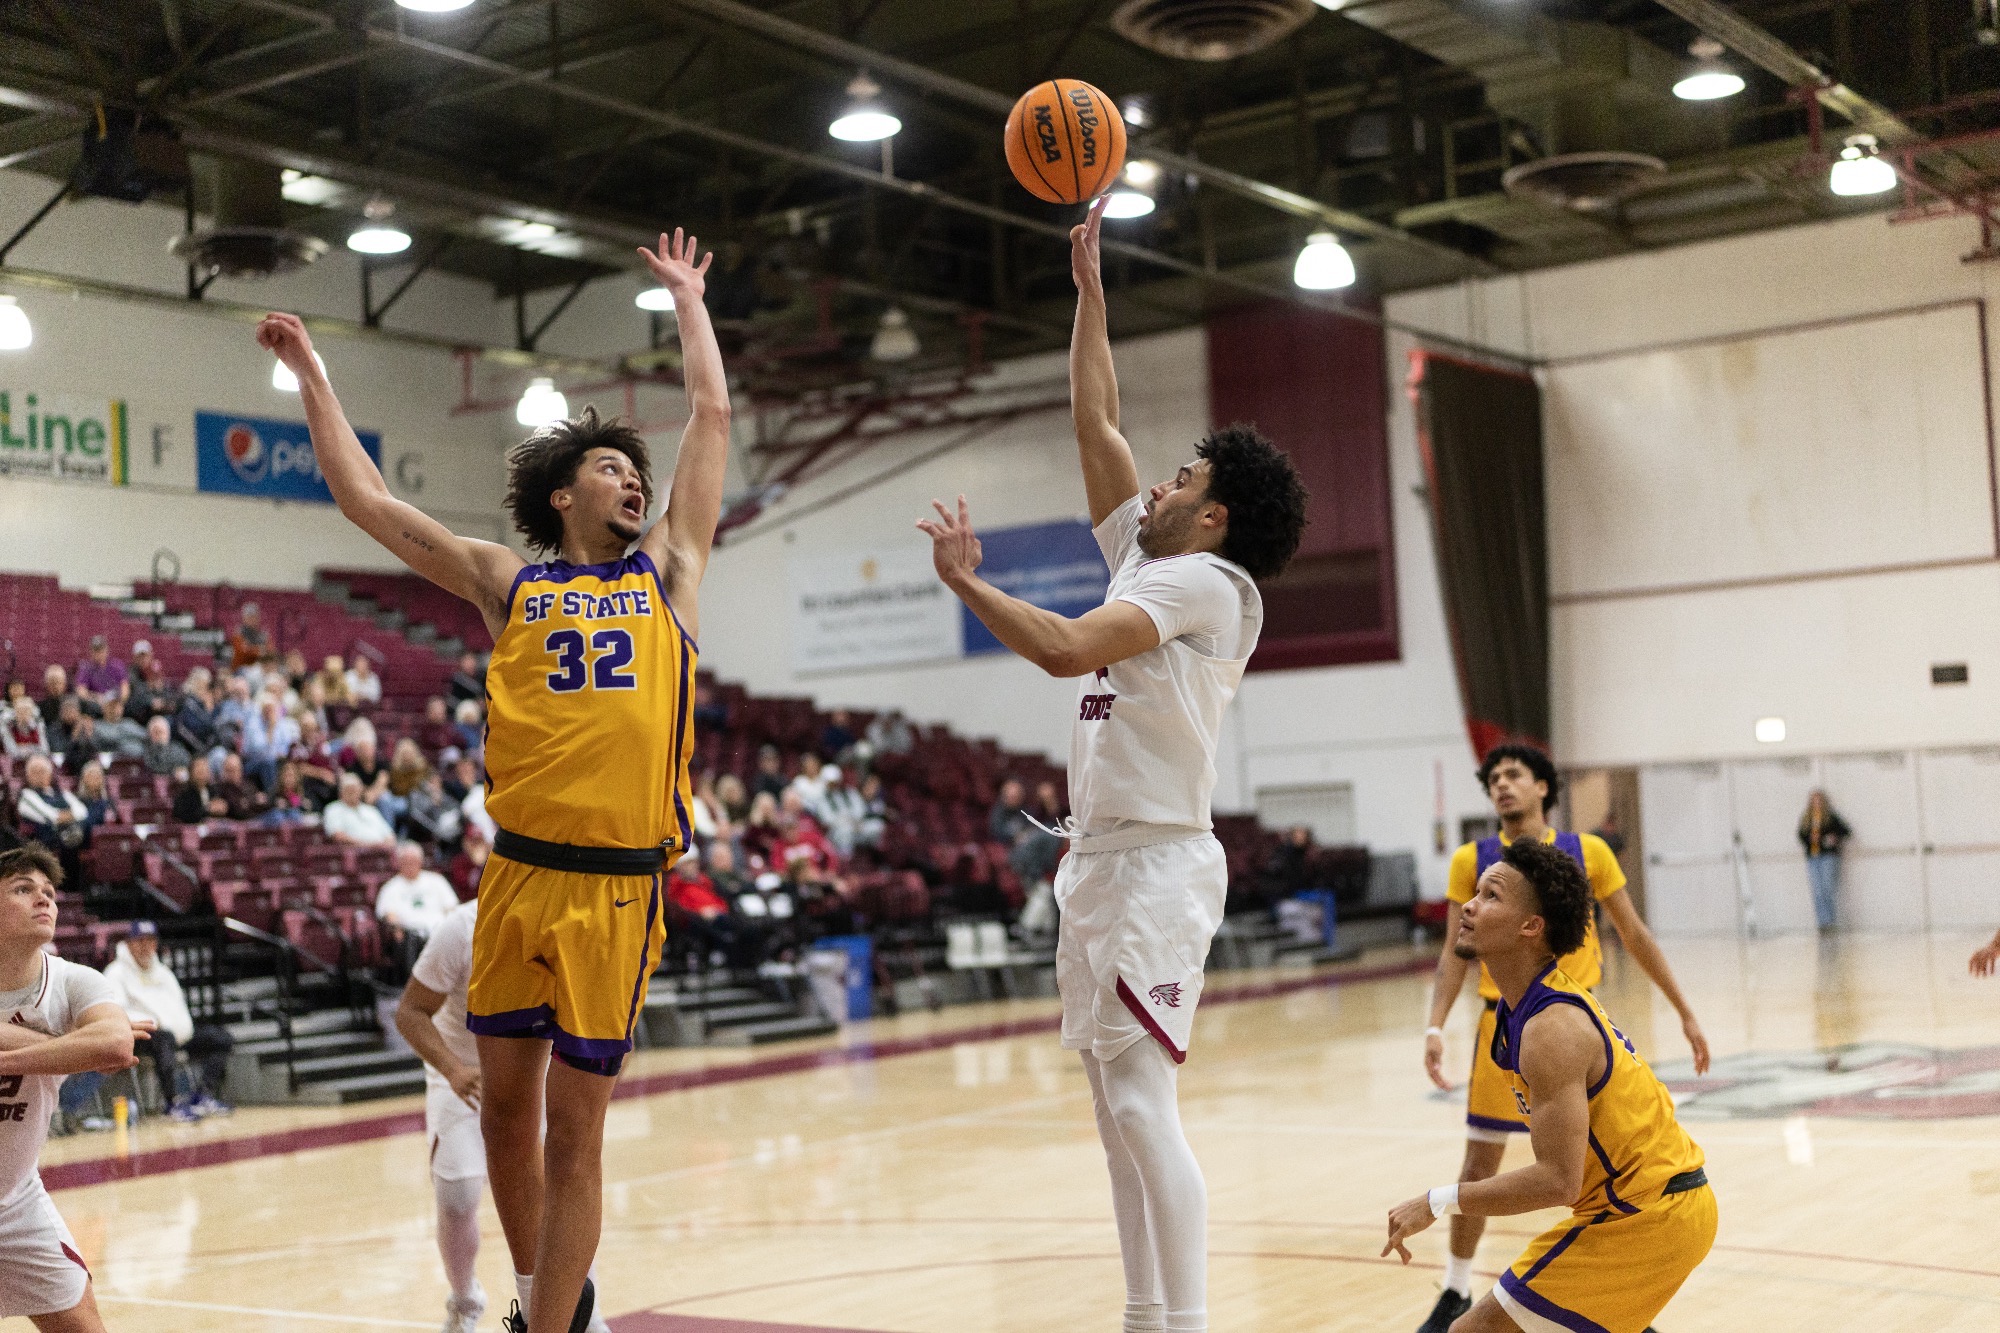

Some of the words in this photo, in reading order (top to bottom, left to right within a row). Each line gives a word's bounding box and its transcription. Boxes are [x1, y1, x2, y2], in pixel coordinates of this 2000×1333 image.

[1034, 104, 1062, 164] NCAA
[1068, 88, 1099, 168] Wilson
[0, 390, 105, 456] Line
[152, 422, 174, 466] F
[396, 452, 424, 494] G
[524, 593, 557, 624] SF
[562, 589, 652, 621] STATE
[544, 627, 638, 694] 32
[1079, 694, 1117, 721] STATE
